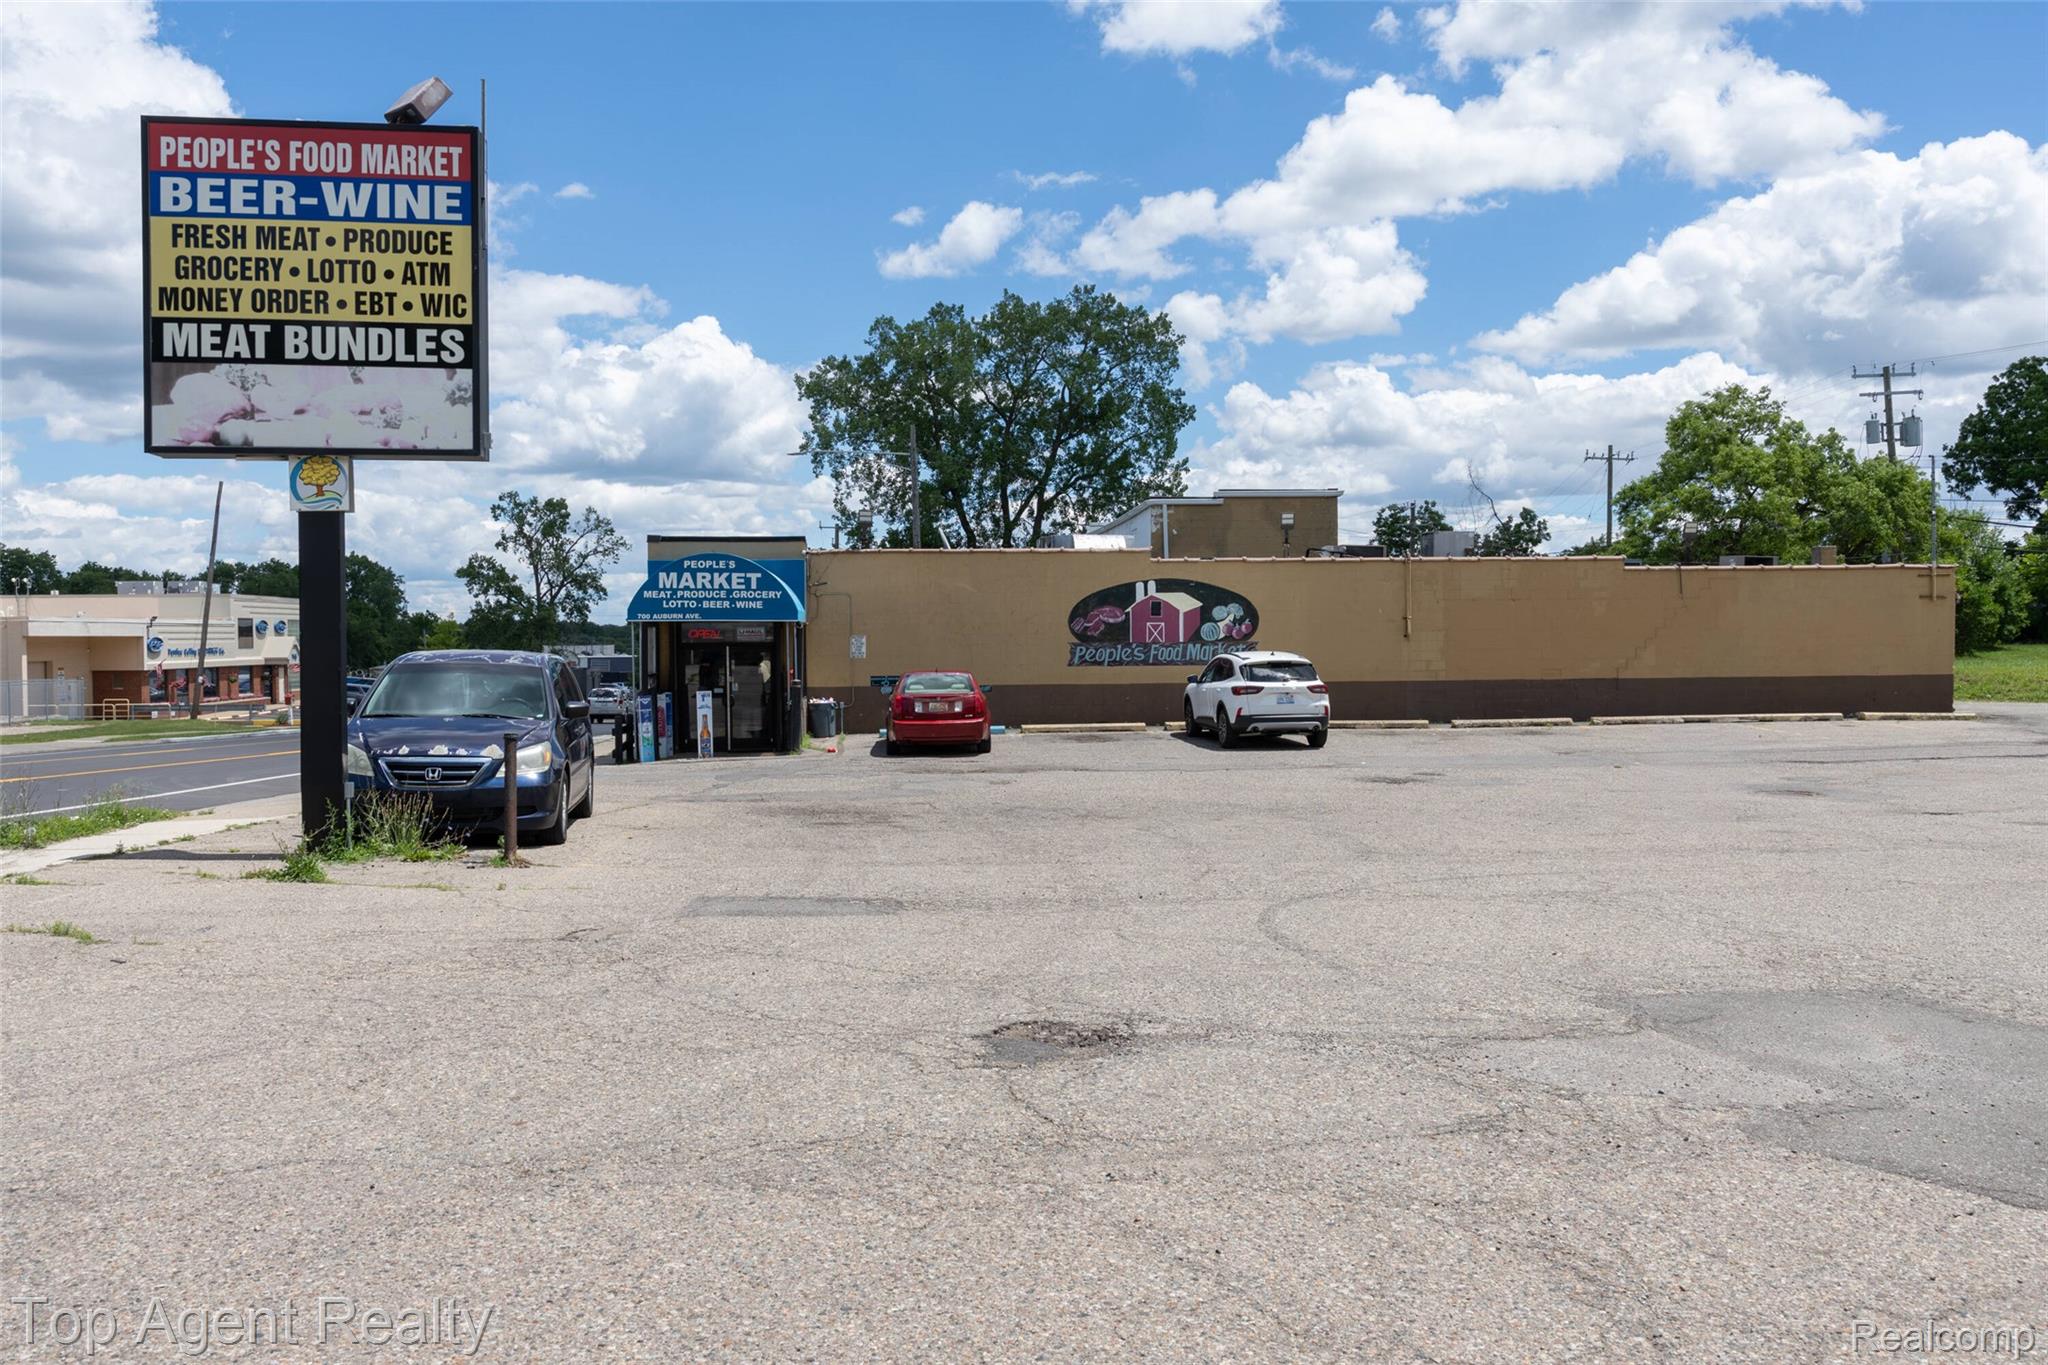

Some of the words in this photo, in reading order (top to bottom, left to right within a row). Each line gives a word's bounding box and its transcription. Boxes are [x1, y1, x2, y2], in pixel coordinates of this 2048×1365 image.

[159, 136, 281, 172] PEOPLE'S
[288, 140, 352, 174] FOOD
[361, 144, 463, 177] MARKET
[159, 176, 464, 221] BEER-WINE
[171, 223, 247, 250] FRESH
[255, 226, 321, 252] MEAT
[343, 228, 453, 256] PRODUCE
[174, 255, 284, 282] GROCERY
[307, 258, 376, 285] LOTTO
[401, 261, 451, 287] ATM
[158, 286, 244, 312] MONEY
[251, 289, 329, 315] ORDER
[354, 292, 398, 317] EBT
[420, 293, 467, 319] WIC
[162, 321, 272, 360] MEAT
[284, 325, 465, 364] BUNDLES
[683, 560, 736, 569] PEOPLE'S
[643, 590, 672, 599] MEAT
[677, 590, 727, 599] PRODUCE
[733, 590, 783, 599] GROCERY
[658, 572, 762, 590] MARKET
[663, 600, 697, 608] LOTTO
[702, 600, 730, 609] BEER
[735, 601, 764, 609] WINE
[1073, 643, 1145, 666] People's
[1150, 644, 1184, 664] Food
